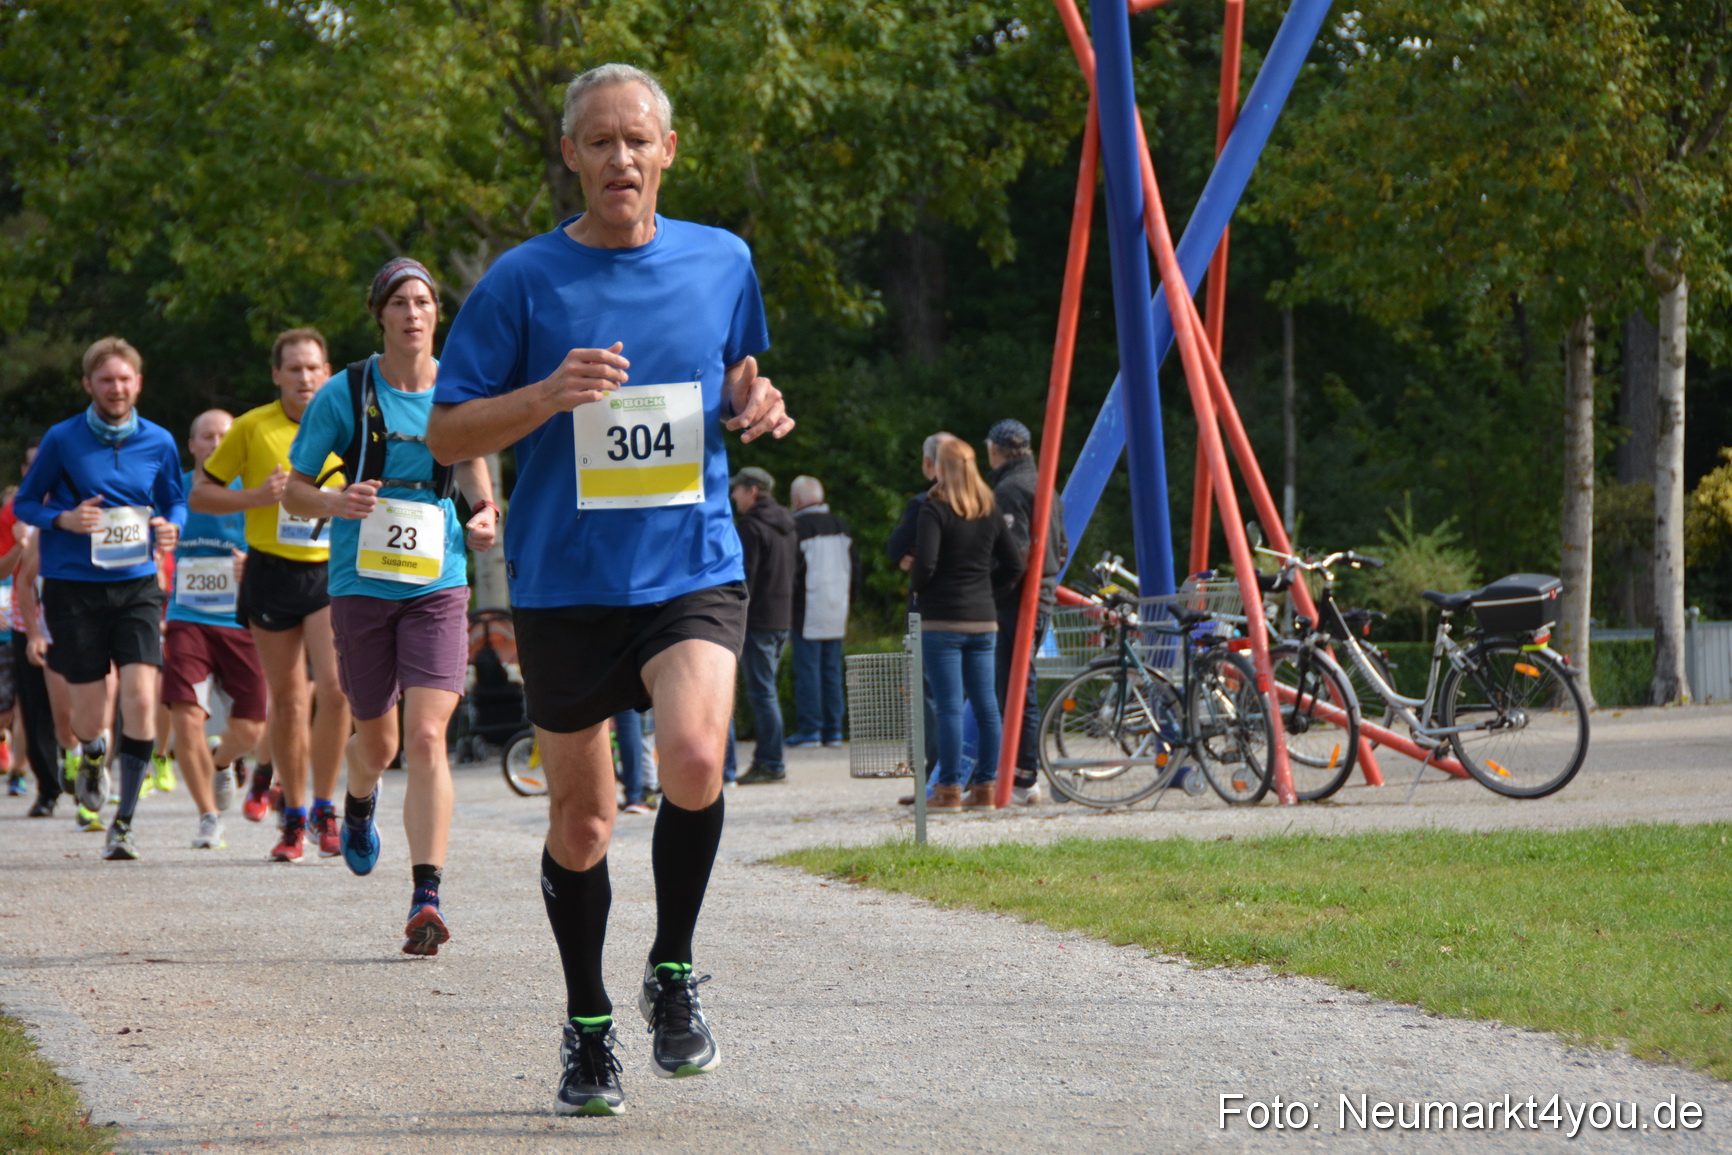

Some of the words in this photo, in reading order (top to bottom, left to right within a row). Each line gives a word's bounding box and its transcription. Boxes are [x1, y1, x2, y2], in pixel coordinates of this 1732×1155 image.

[622, 395, 665, 408] BOCK
[606, 422, 675, 461] 304
[103, 524, 141, 545] 2928
[386, 525, 418, 550] 23
[381, 556, 418, 568] Susanne
[186, 573, 228, 591] 2380
